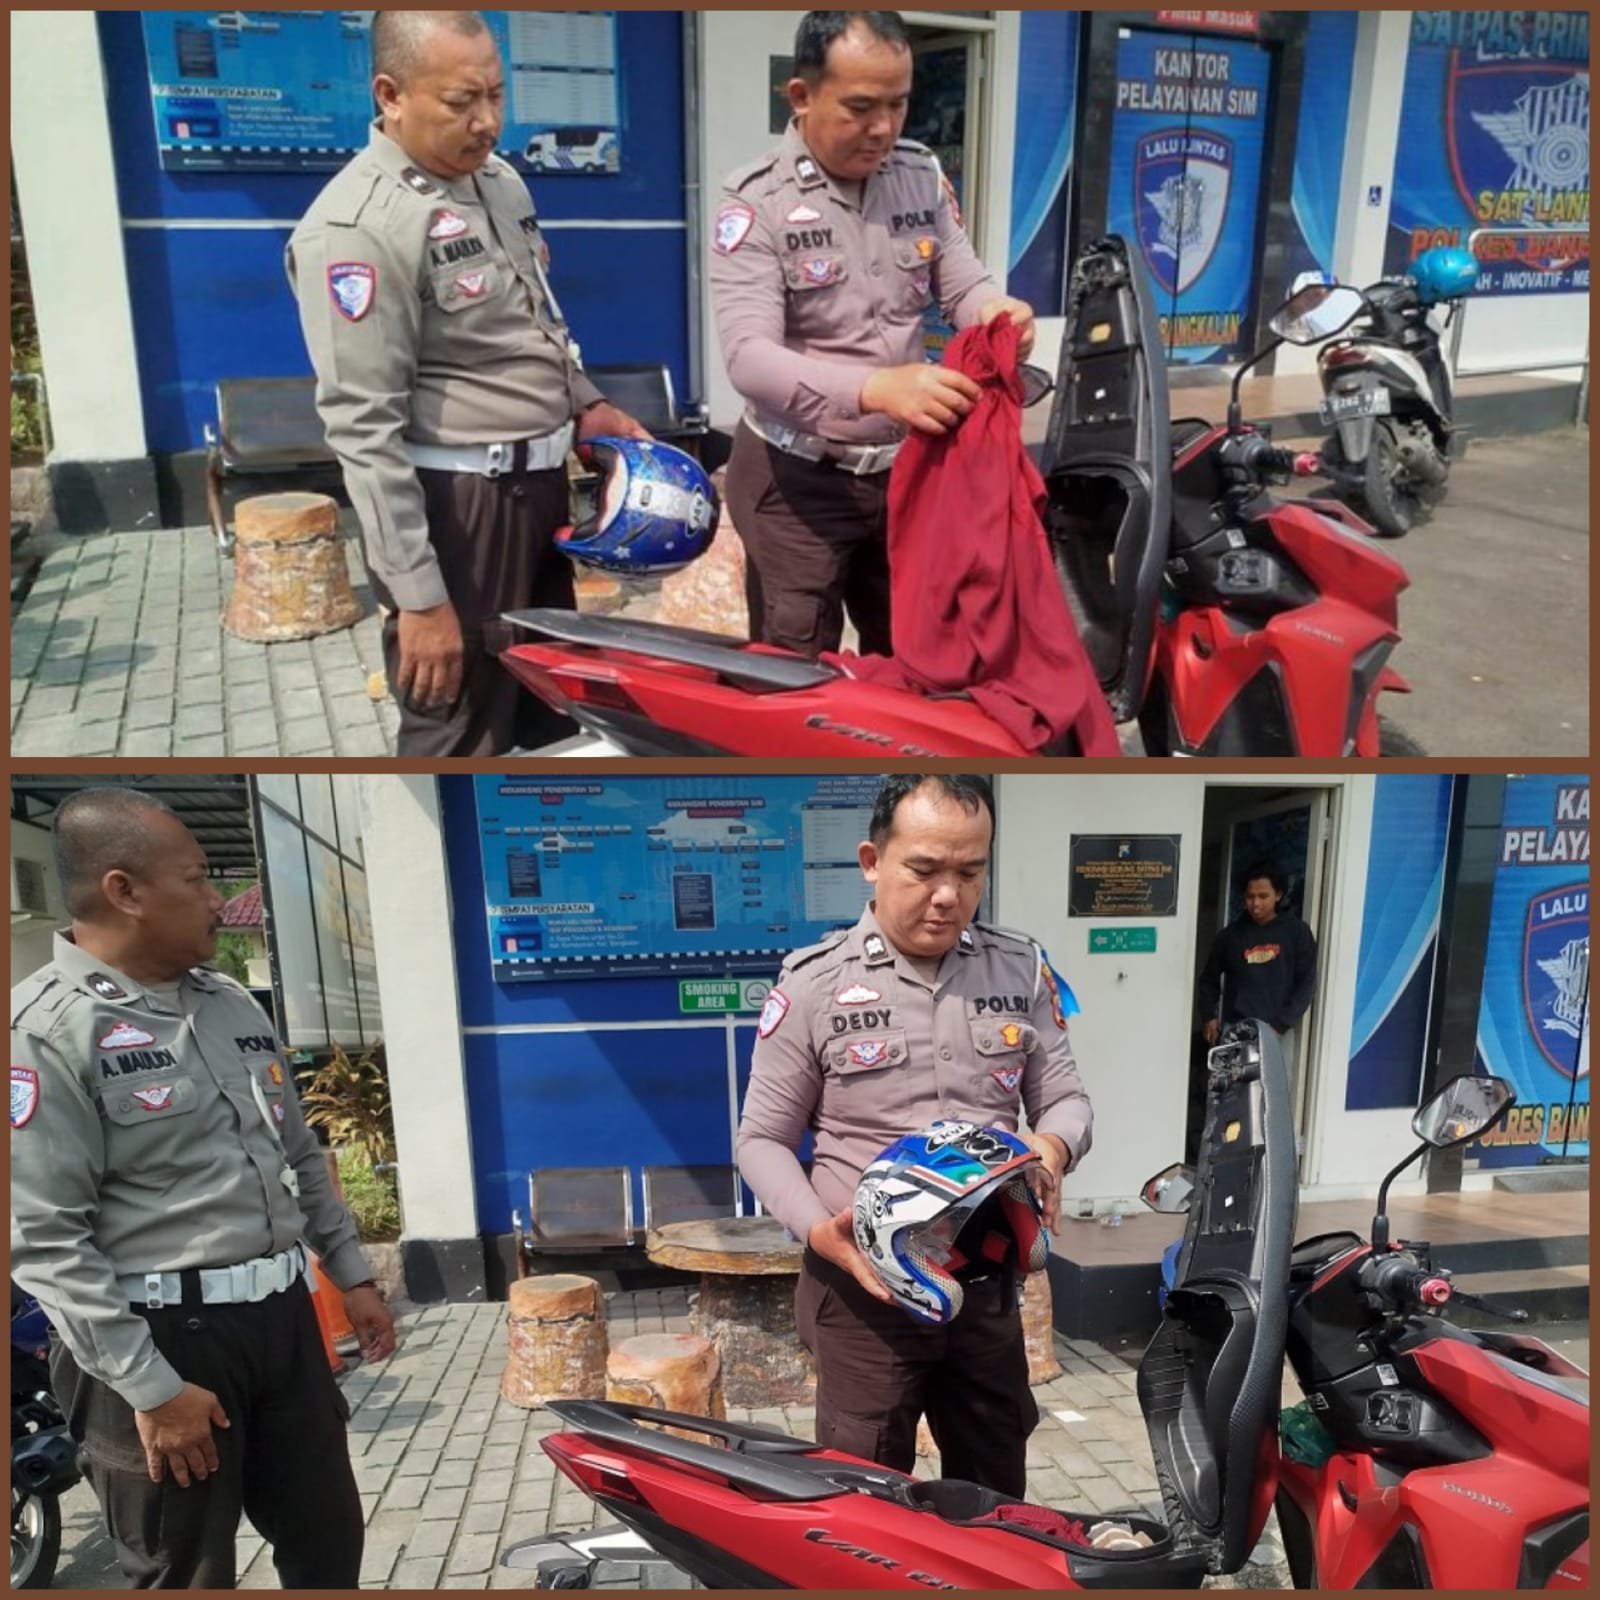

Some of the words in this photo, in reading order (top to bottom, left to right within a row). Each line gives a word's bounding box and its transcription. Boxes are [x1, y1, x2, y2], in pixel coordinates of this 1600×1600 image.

[1155, 50, 1229, 80] KANTOR
[1117, 82, 1224, 112] PELAYANAN
[1227, 90, 1258, 115] SIM
[1146, 138, 1178, 158] LALU
[1478, 190, 1529, 220] SAT
[785, 228, 833, 251] DEDY
[1503, 271, 1563, 290] INOVATIF
[1540, 893, 1587, 920] LALU
[685, 983, 737, 995] SMOKING
[697, 996, 726, 1008] AREA
[975, 995, 1029, 1015] POLRI
[833, 1010, 891, 1033] DEDY
